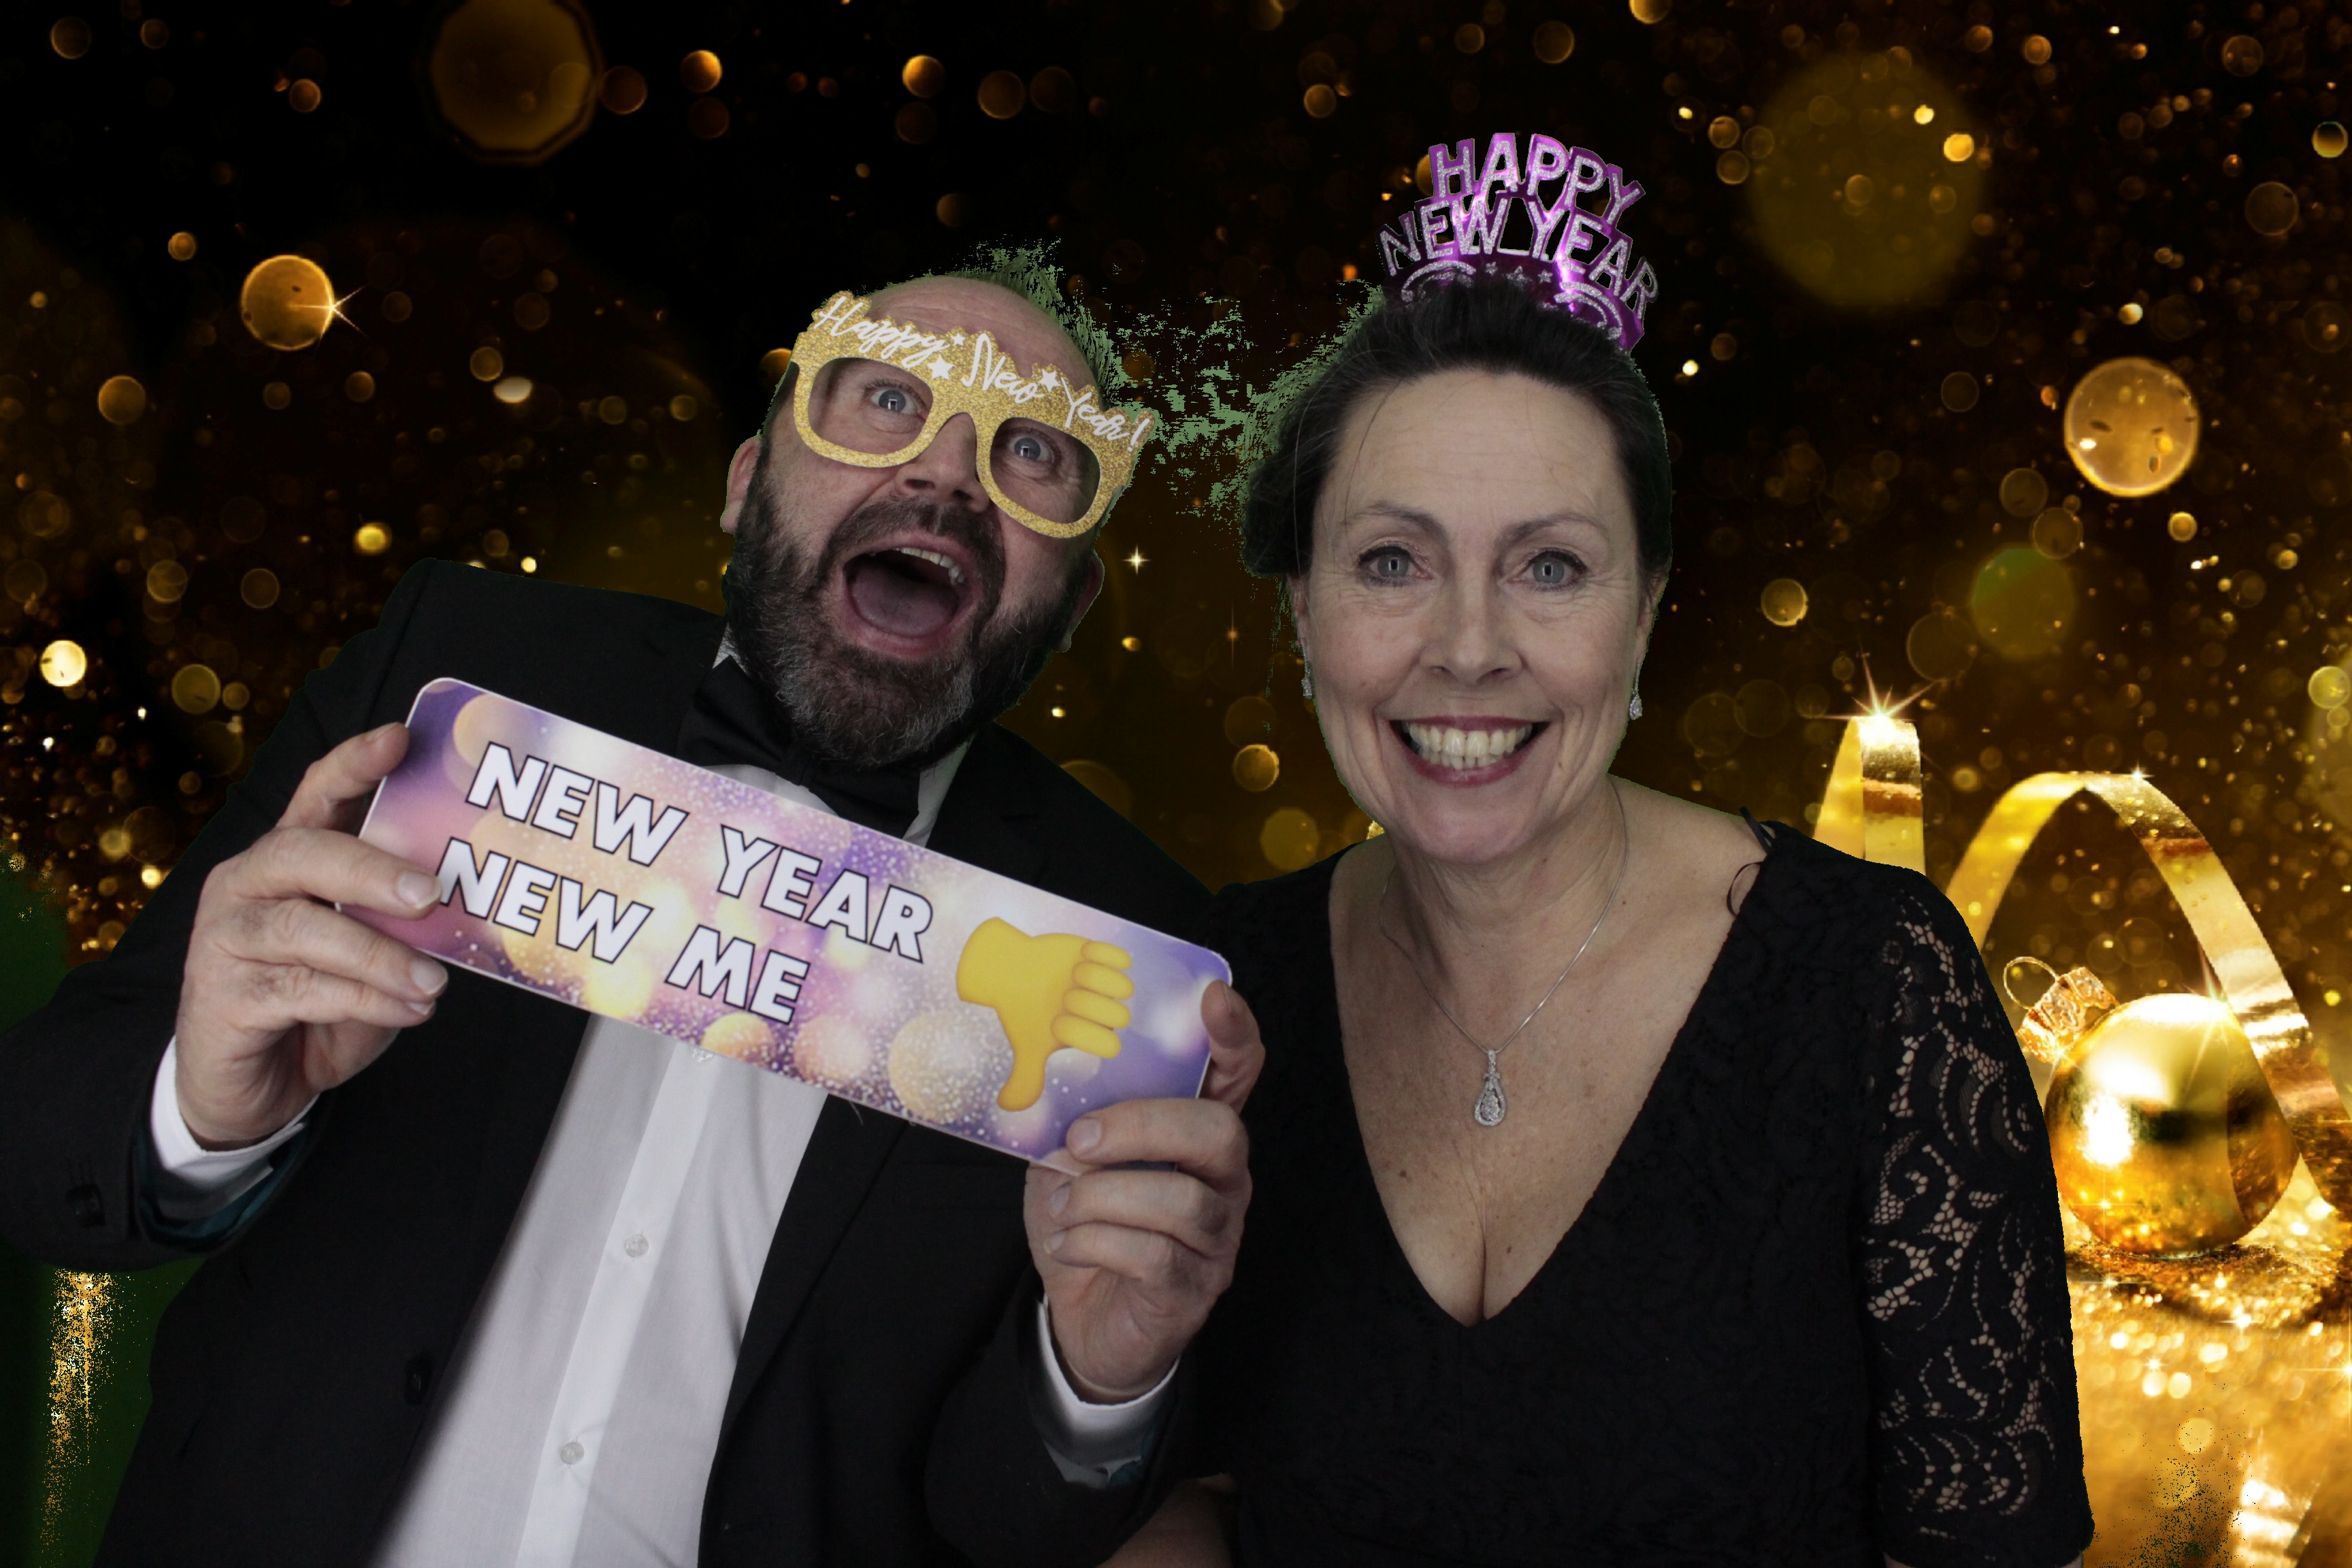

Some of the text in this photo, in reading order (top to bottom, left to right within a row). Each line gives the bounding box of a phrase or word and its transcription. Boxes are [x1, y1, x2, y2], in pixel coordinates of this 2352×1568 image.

[1431, 133, 1644, 225] HAPPY
[1377, 197, 1659, 321] NEW YEAR
[814, 296, 1150, 452] Happy New Year!
[436, 836, 810, 1025] NEW ME
[466, 741, 934, 964] NEW YEAR
